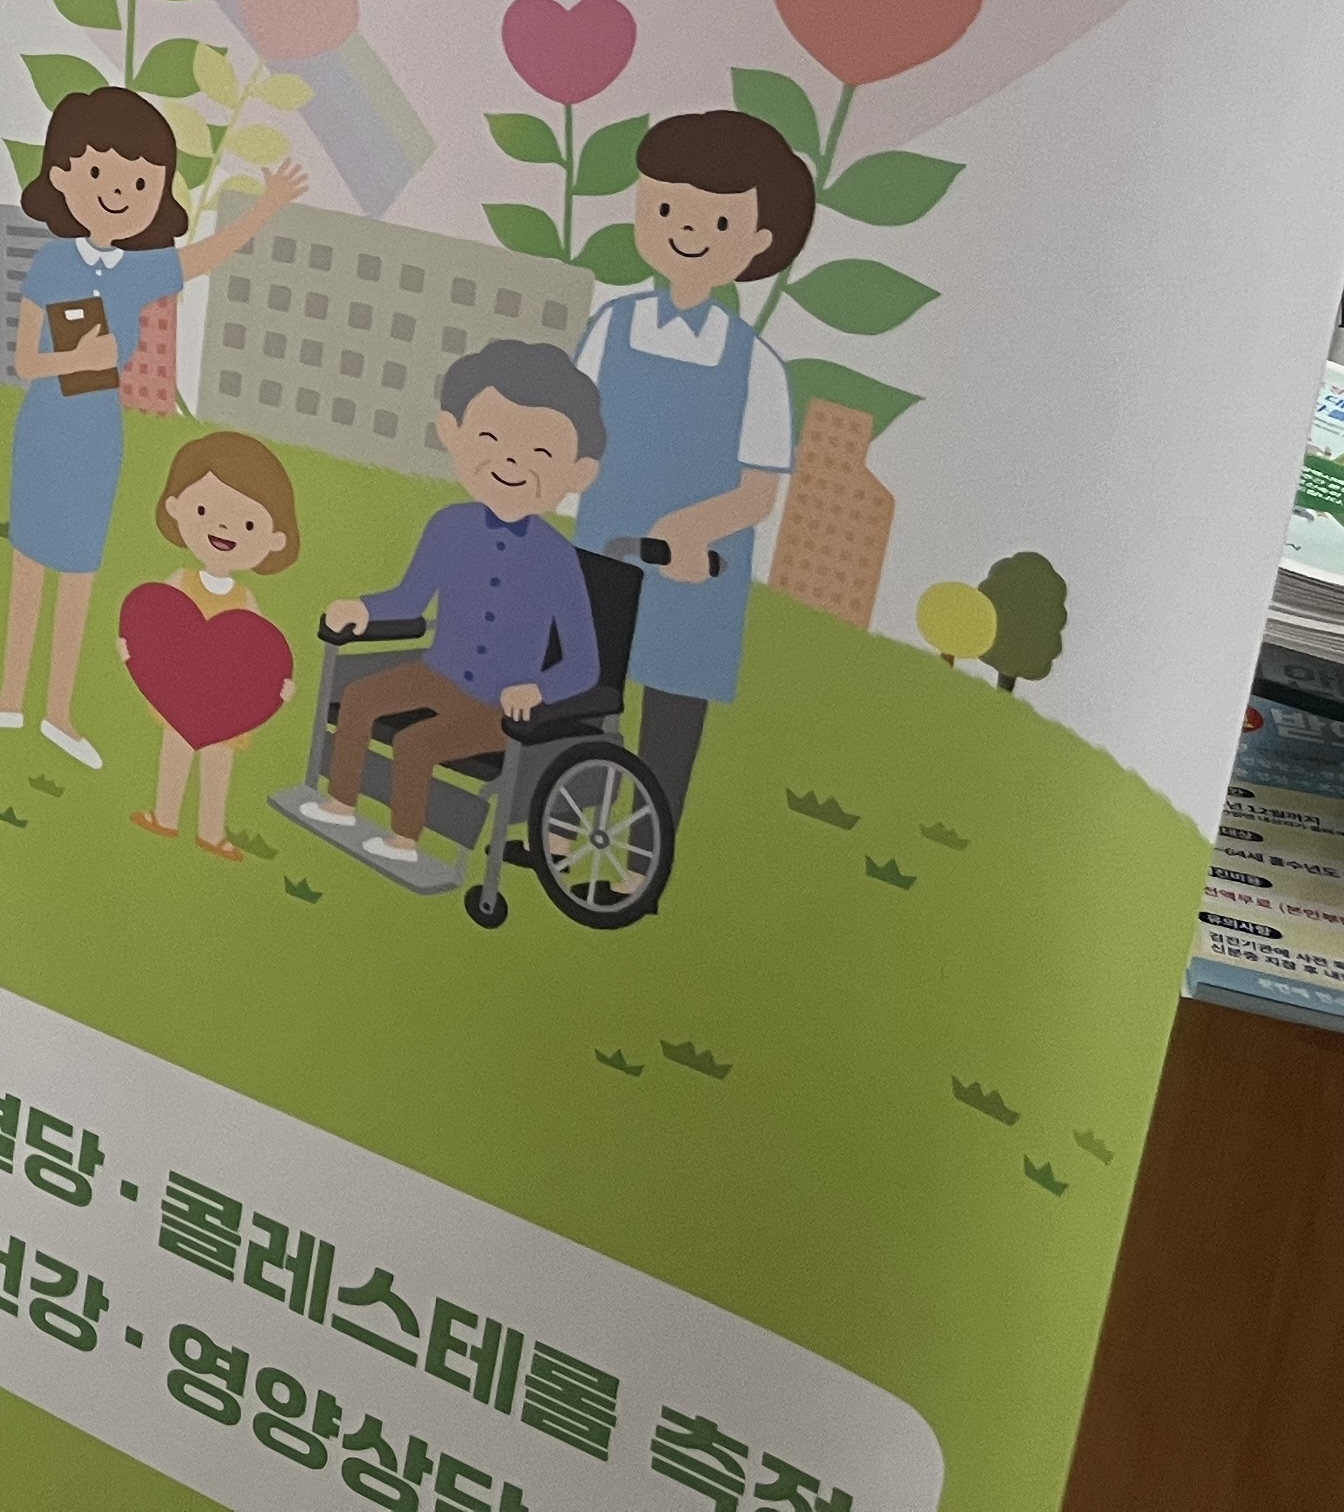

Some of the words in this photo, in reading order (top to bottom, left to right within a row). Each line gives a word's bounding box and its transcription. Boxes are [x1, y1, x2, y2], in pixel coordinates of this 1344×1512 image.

[1204, 886, 1273, 910] 전액무료
[1278, 902, 1344, 926] (본인부
[1205, 913, 1271, 937] 유의사항
[1209, 931, 1291, 959] 검진기관에
[1210, 943, 1259, 962] 신분증
